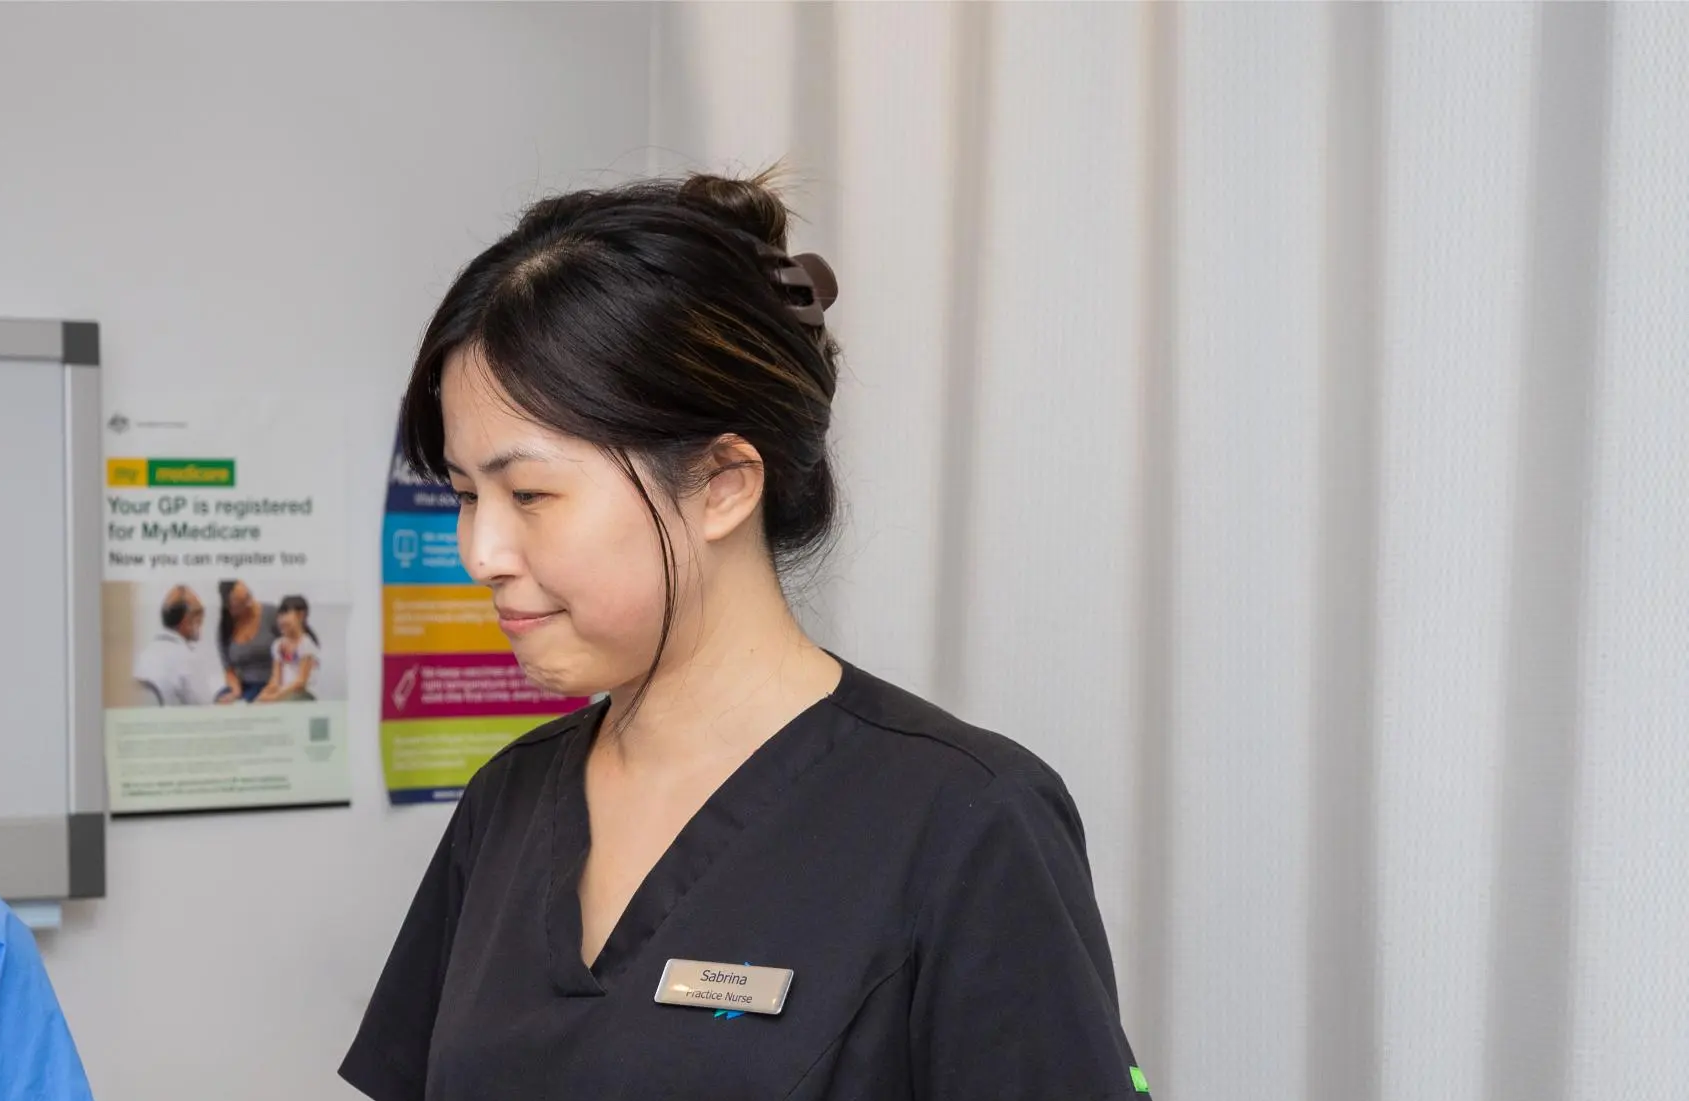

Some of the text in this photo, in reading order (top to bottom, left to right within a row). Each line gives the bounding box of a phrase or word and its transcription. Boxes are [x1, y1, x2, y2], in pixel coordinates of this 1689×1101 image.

[156, 464, 229, 482] medicare
[108, 497, 313, 518] Your GP is registered
[108, 522, 261, 543] for MyMedicare
[109, 551, 307, 568] Now you can register too
[700, 969, 748, 985] Sabrina
[725, 991, 753, 1004] Nurse
